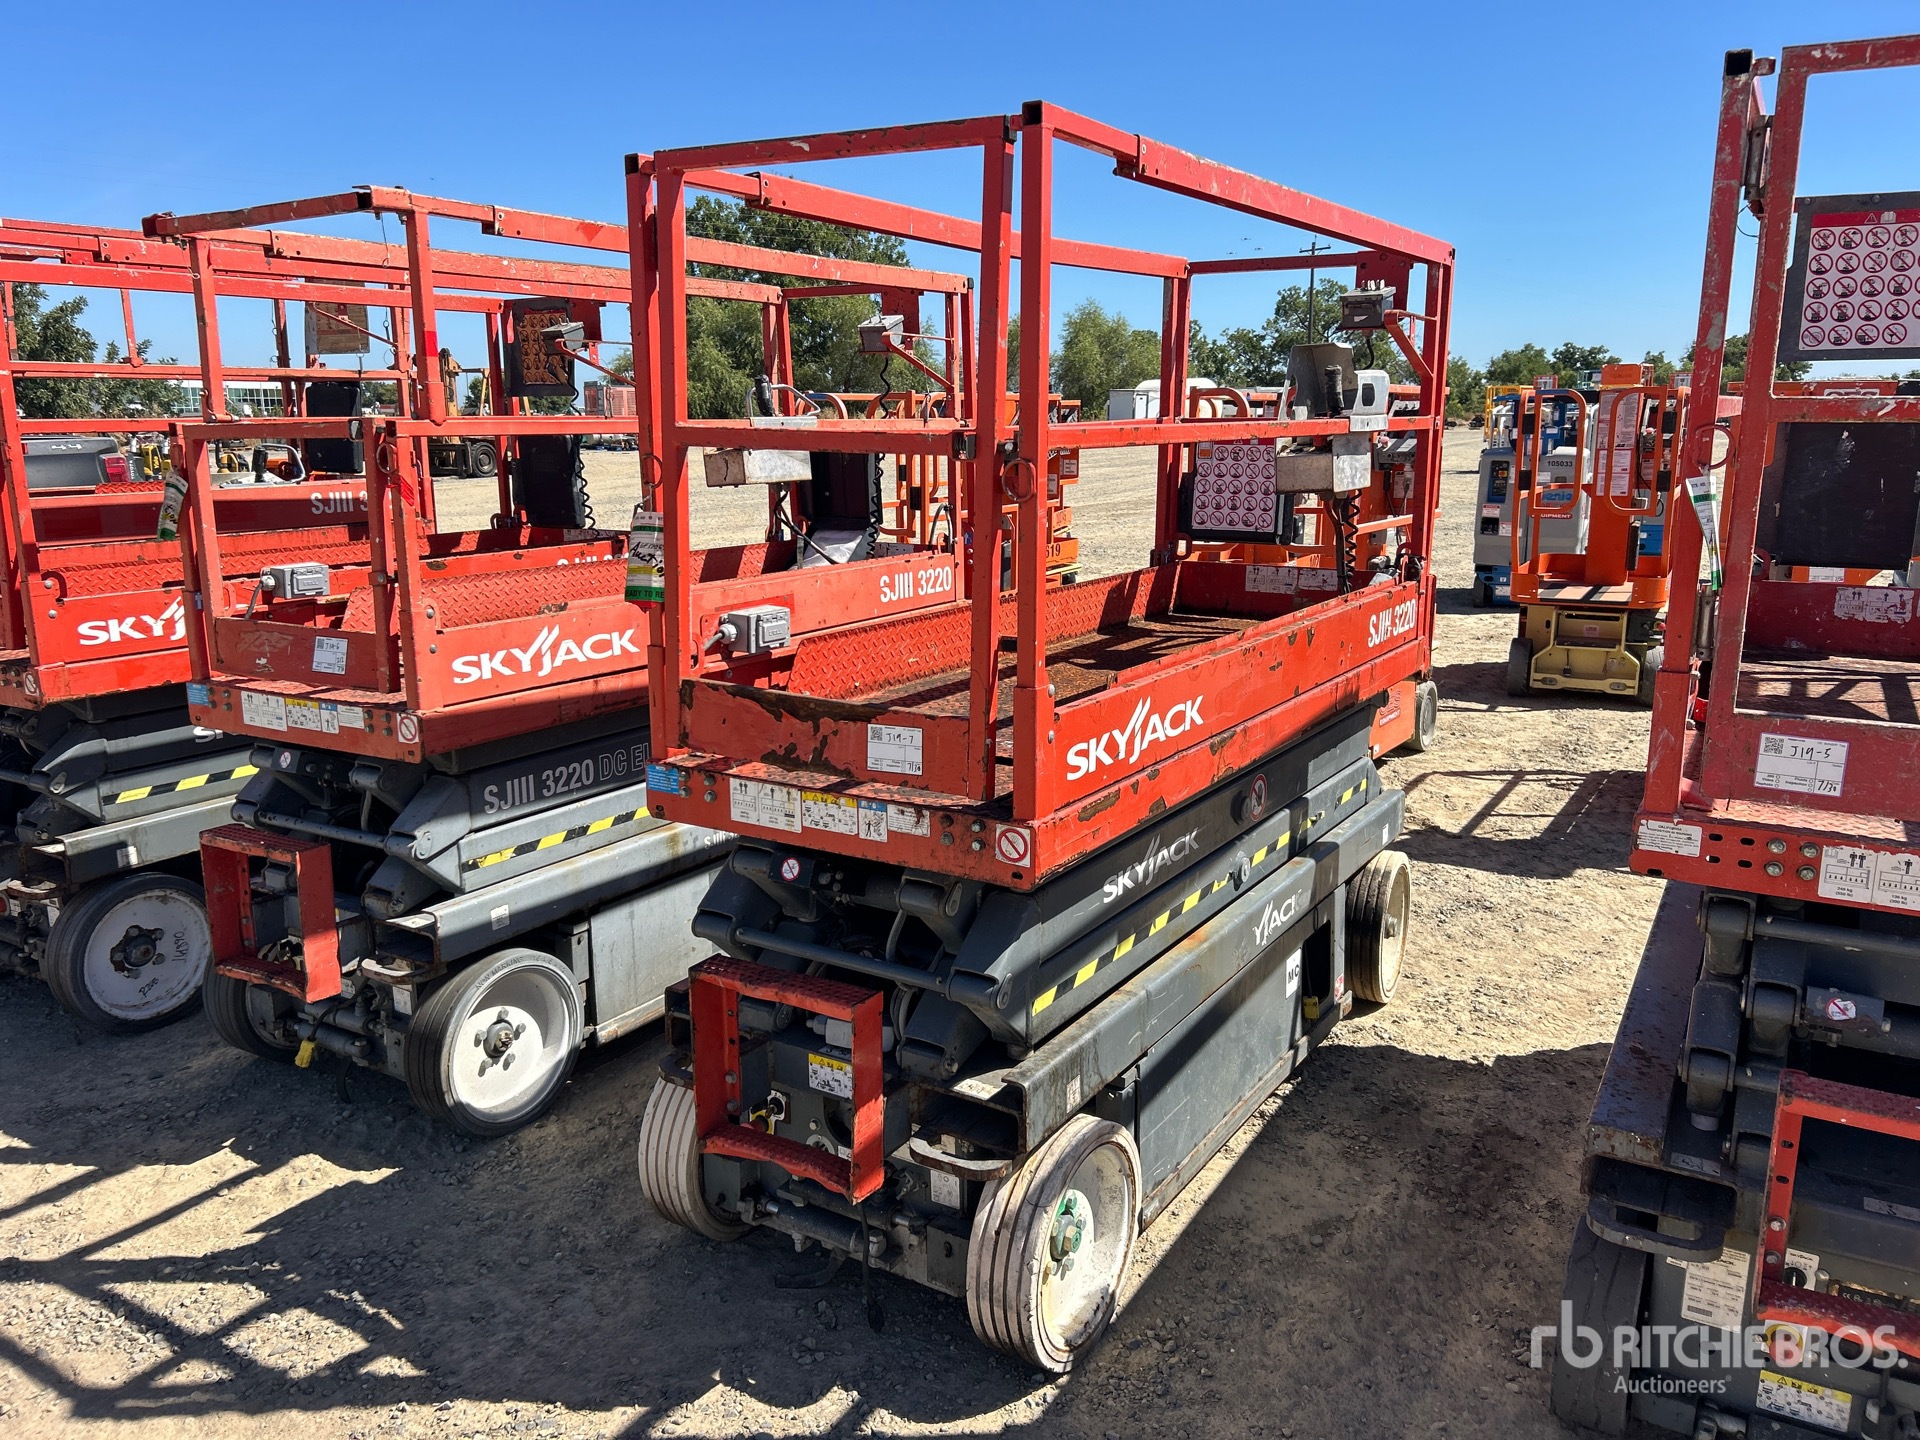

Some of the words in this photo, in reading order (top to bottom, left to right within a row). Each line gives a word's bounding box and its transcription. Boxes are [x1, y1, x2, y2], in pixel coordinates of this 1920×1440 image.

[626, 589, 642, 598] EADY
[880, 571, 914, 603] SJIII
[917, 565, 953, 596] 3220
[1393, 598, 1417, 636] 3220
[452, 624, 641, 684] SKYJACK
[885, 732, 914, 744] J19-7
[1066, 696, 1205, 782] SKYJACK
[1790, 745, 1832, 761] J19-5
[484, 774, 536, 814] SJIII
[541, 759, 595, 798] 3220
[599, 749, 627, 782] DC
[1103, 827, 1200, 904] SKYJACK
